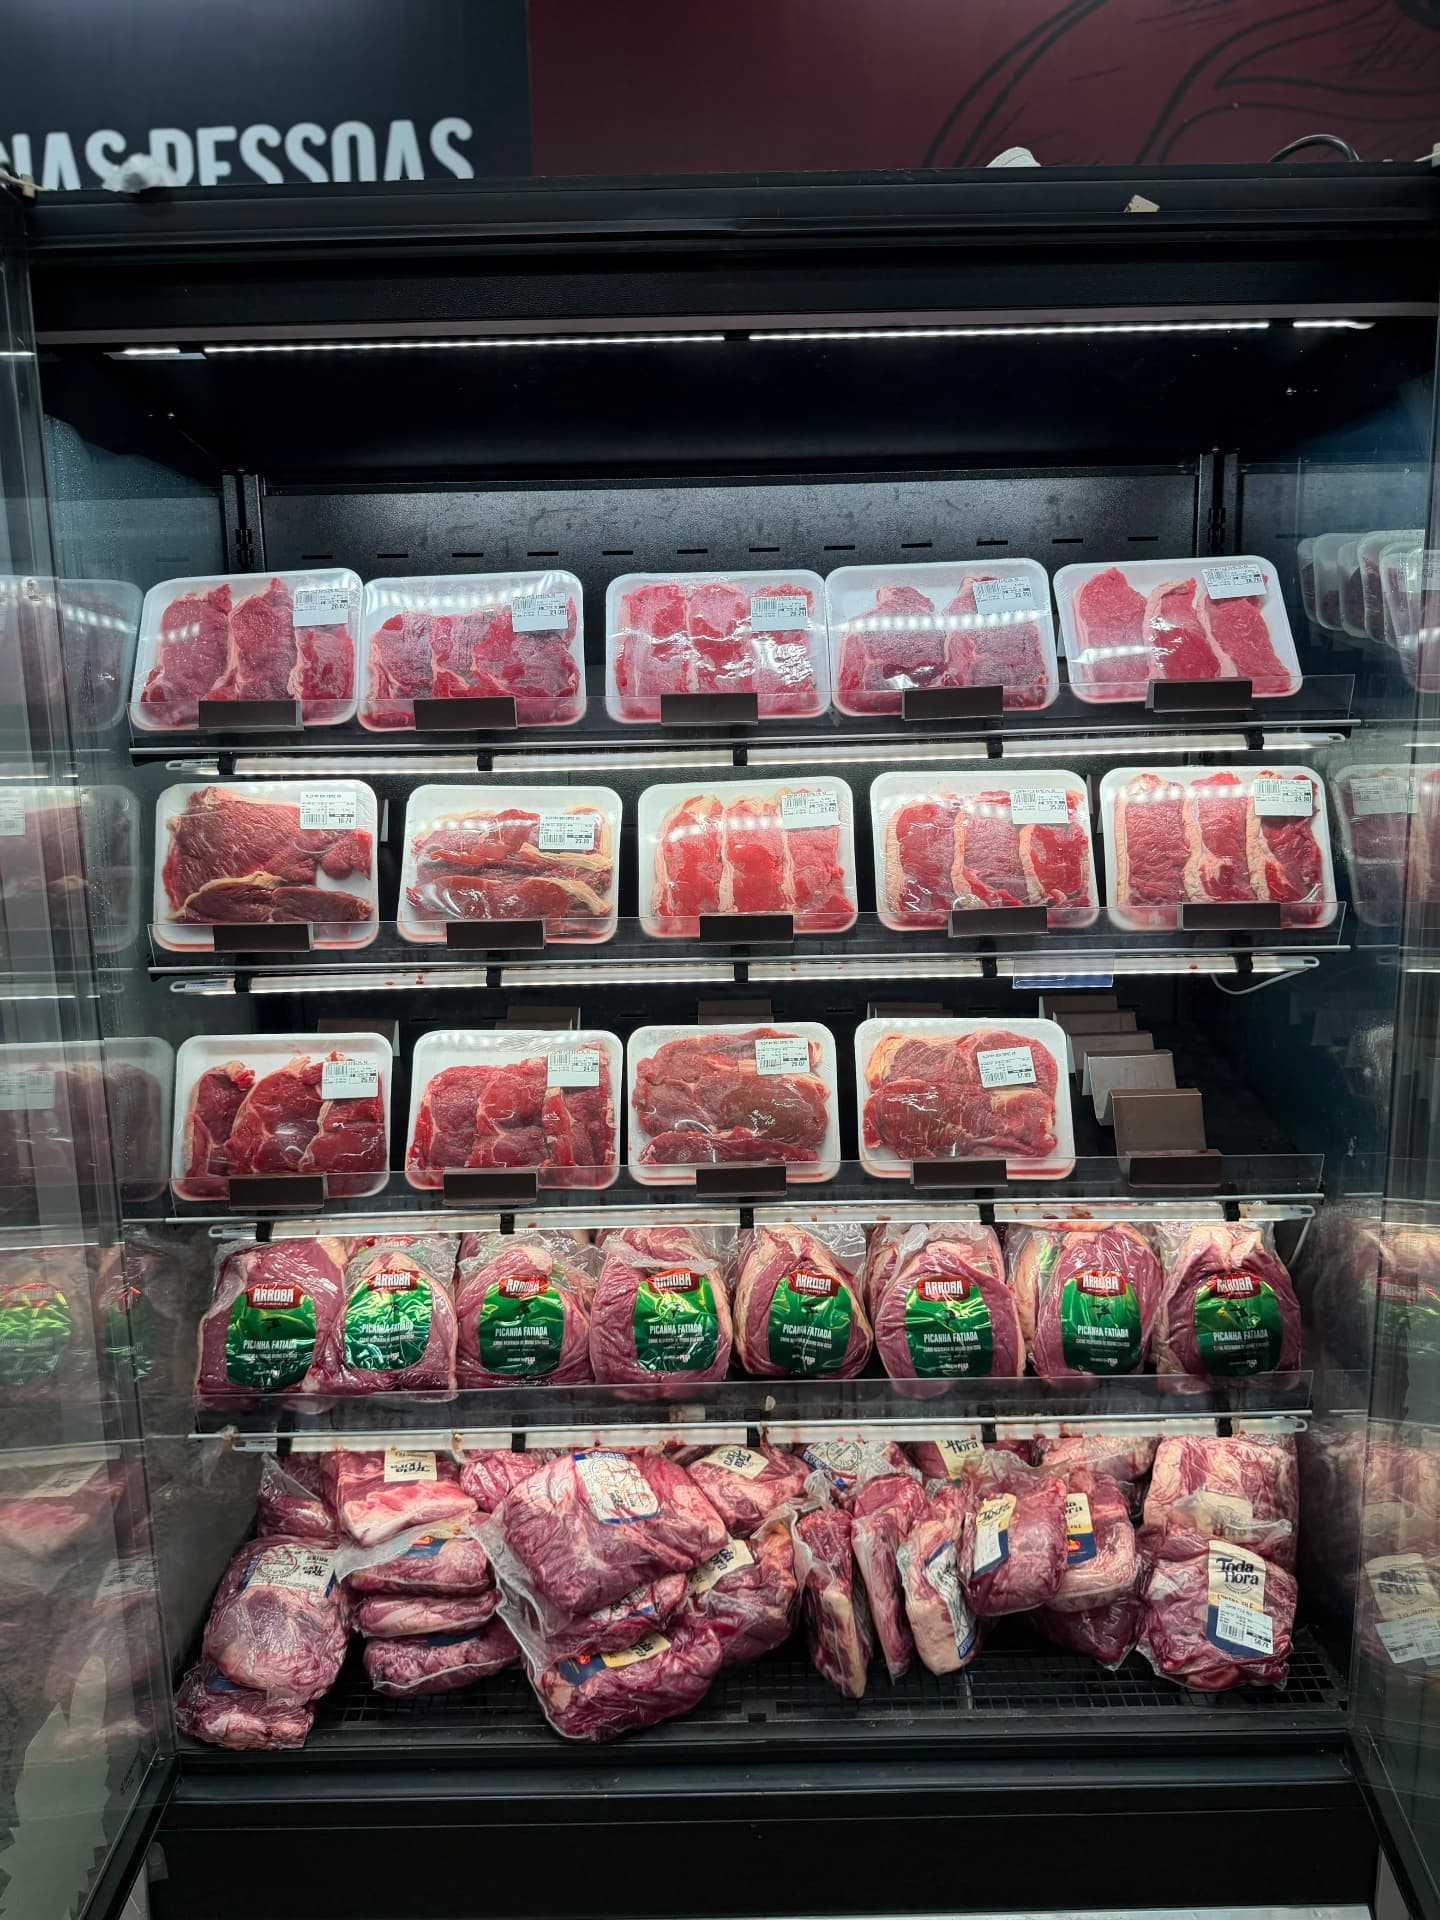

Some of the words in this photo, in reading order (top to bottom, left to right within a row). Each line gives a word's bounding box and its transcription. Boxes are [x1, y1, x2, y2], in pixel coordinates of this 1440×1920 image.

[375, 1272, 411, 1287] ARROBA
[796, 1273, 832, 1292] ARROBA
[1217, 1276, 1254, 1293] ARROBA
[253, 1287, 294, 1303] ARROBA
[925, 1280, 963, 1296] ARROBA
[495, 1327, 522, 1337] PICANHA
[523, 1326, 548, 1337] FATIADA
[649, 1325, 677, 1335] PICANHA
[807, 1326, 832, 1339] FATIADA
[923, 1333, 952, 1343] PICANHA
[952, 1331, 979, 1343] FATIADA
[1077, 1325, 1104, 1337] PICANHA
[1104, 1327, 1129, 1338] FATIADA
[1212, 1331, 1242, 1342] PICANHA
[1243, 1329, 1269, 1340] FATIADA
[243, 1339, 270, 1351] PICANHA
[1216, 1557, 1254, 1573] Toda
[1217, 1571, 1259, 1586] Hora
